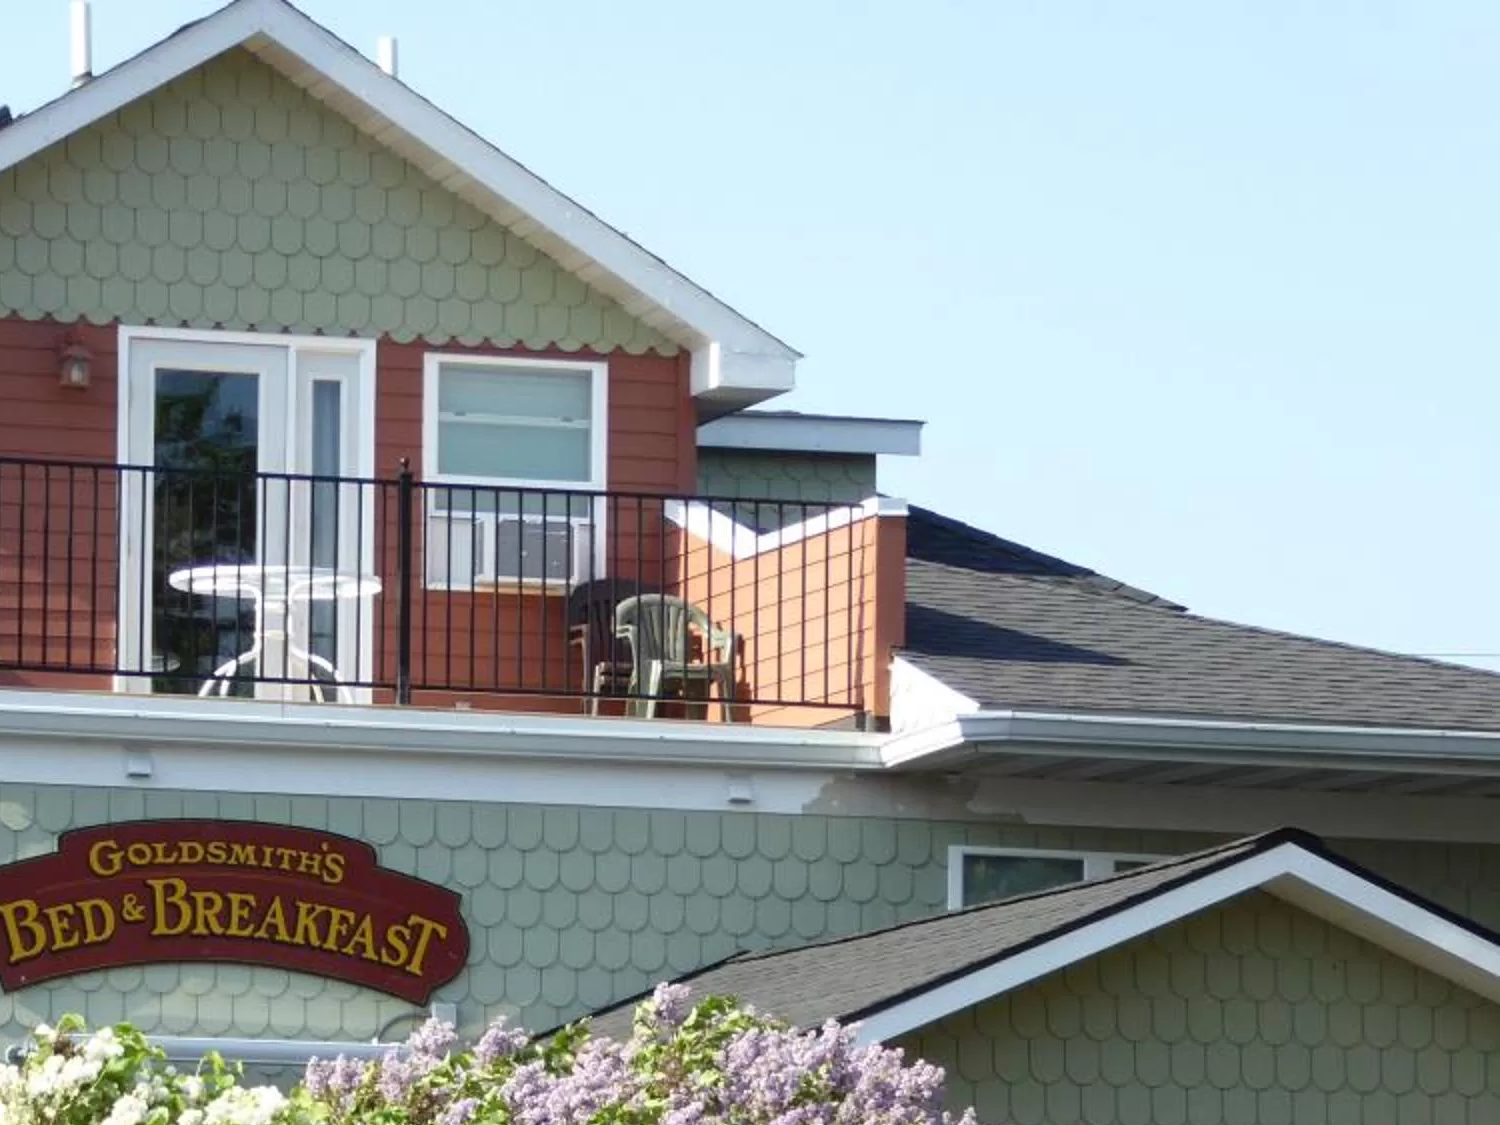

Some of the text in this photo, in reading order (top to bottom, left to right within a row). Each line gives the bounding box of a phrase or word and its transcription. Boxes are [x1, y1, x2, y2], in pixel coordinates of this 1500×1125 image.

[89, 840, 345, 883] GOLDSMITH'S
[122, 894, 146, 921] &
[146, 878, 446, 976] BREAKFAST
